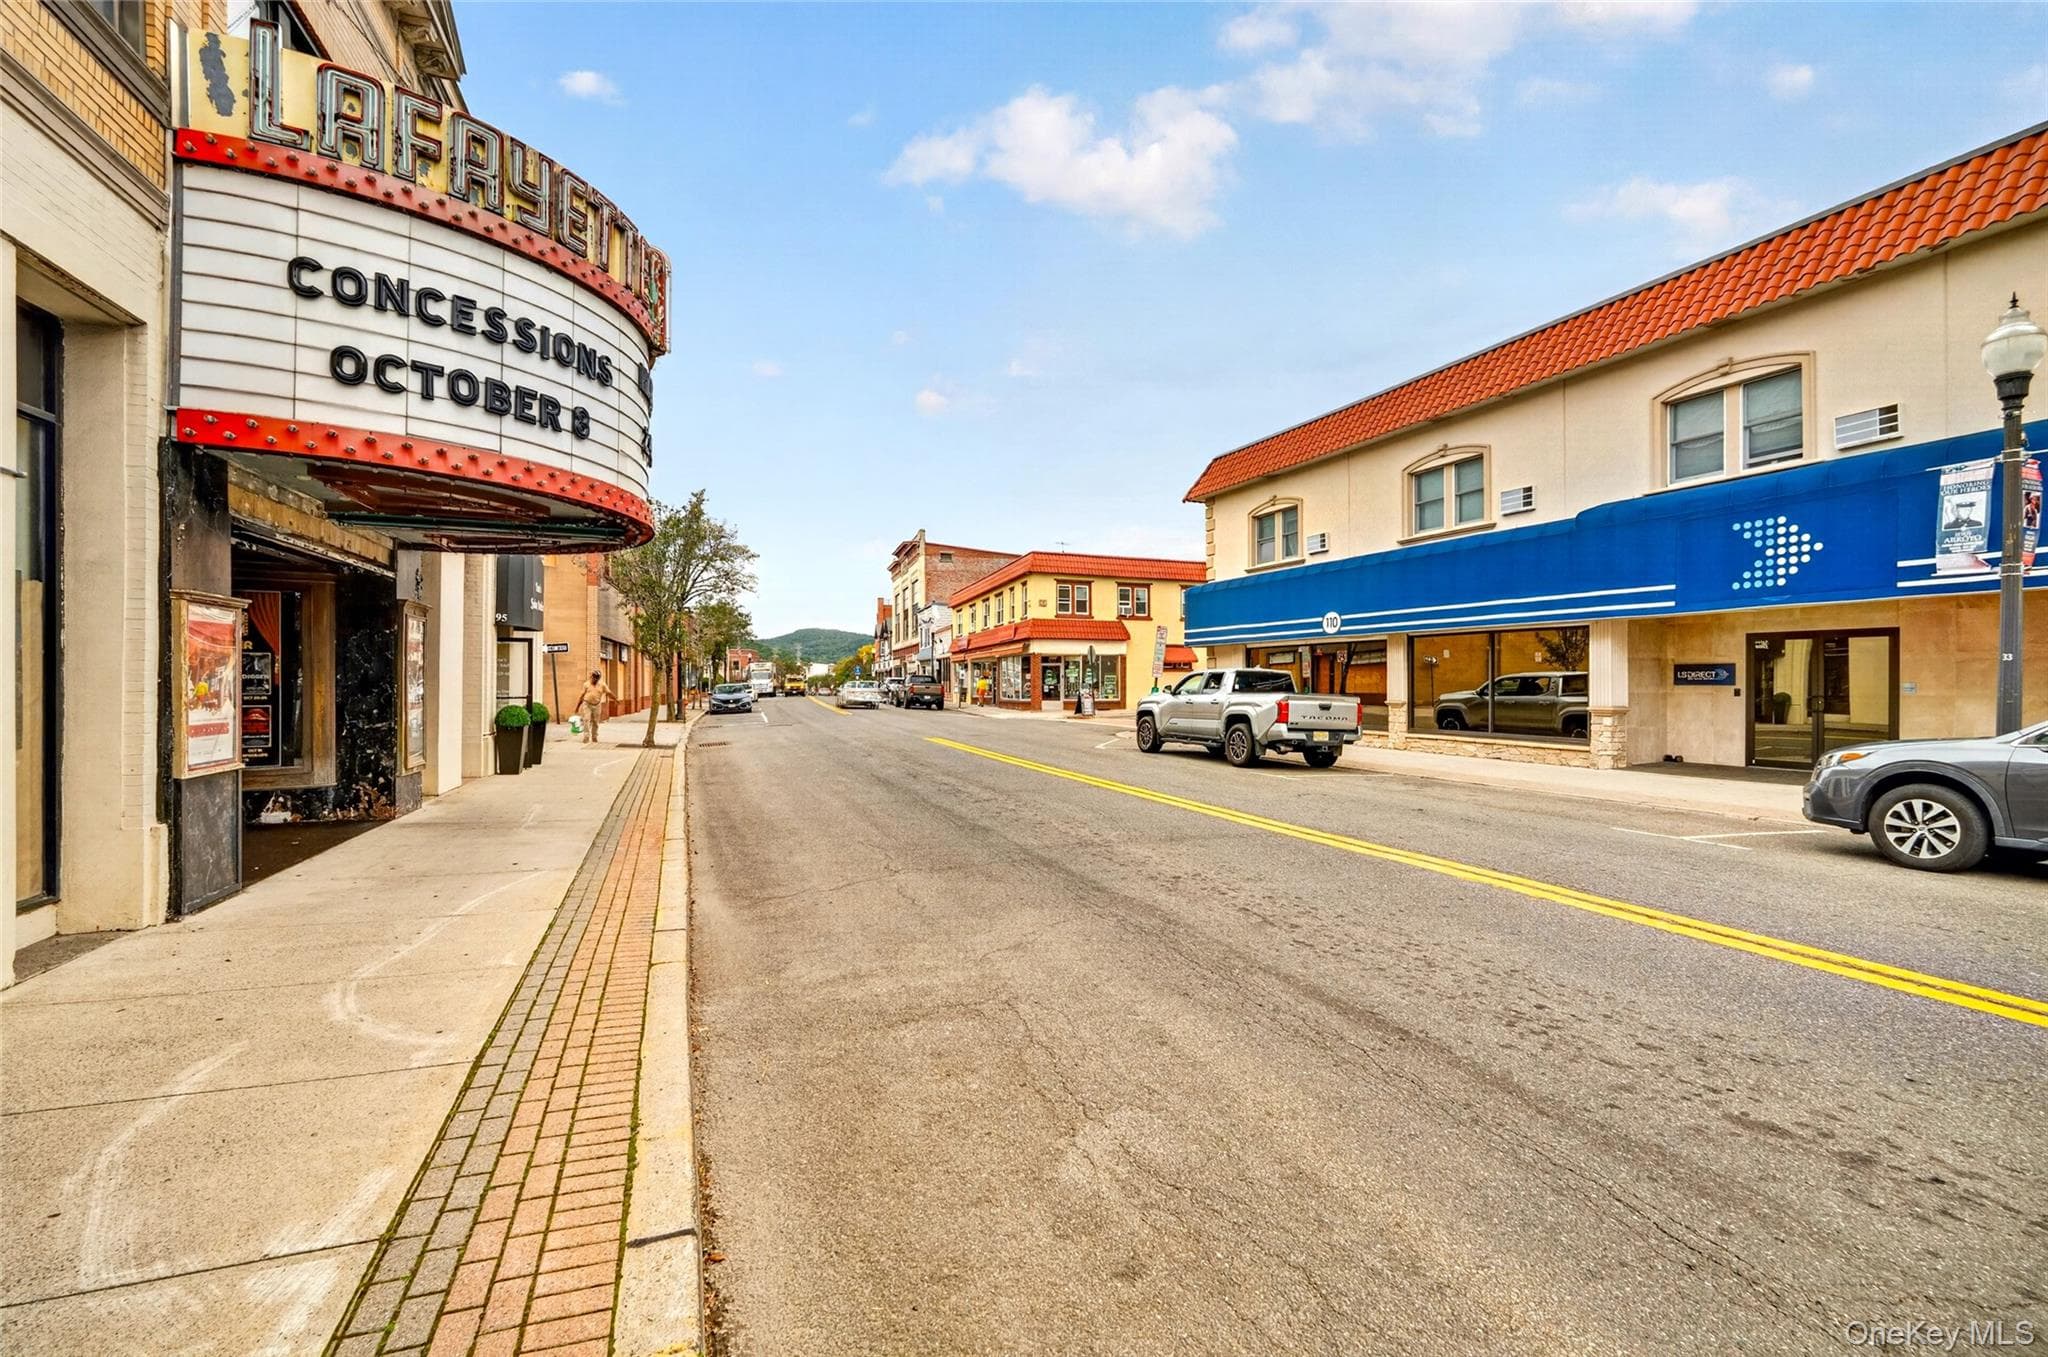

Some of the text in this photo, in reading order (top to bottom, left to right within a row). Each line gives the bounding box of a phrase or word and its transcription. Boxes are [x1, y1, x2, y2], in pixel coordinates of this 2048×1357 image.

[287, 255, 614, 388] CONCESSIONS
[329, 344, 591, 440] OCTOBER 8
[496, 612, 508, 622] 95
[1326, 616, 1338, 628] 110
[2002, 653, 2013, 661] 33
